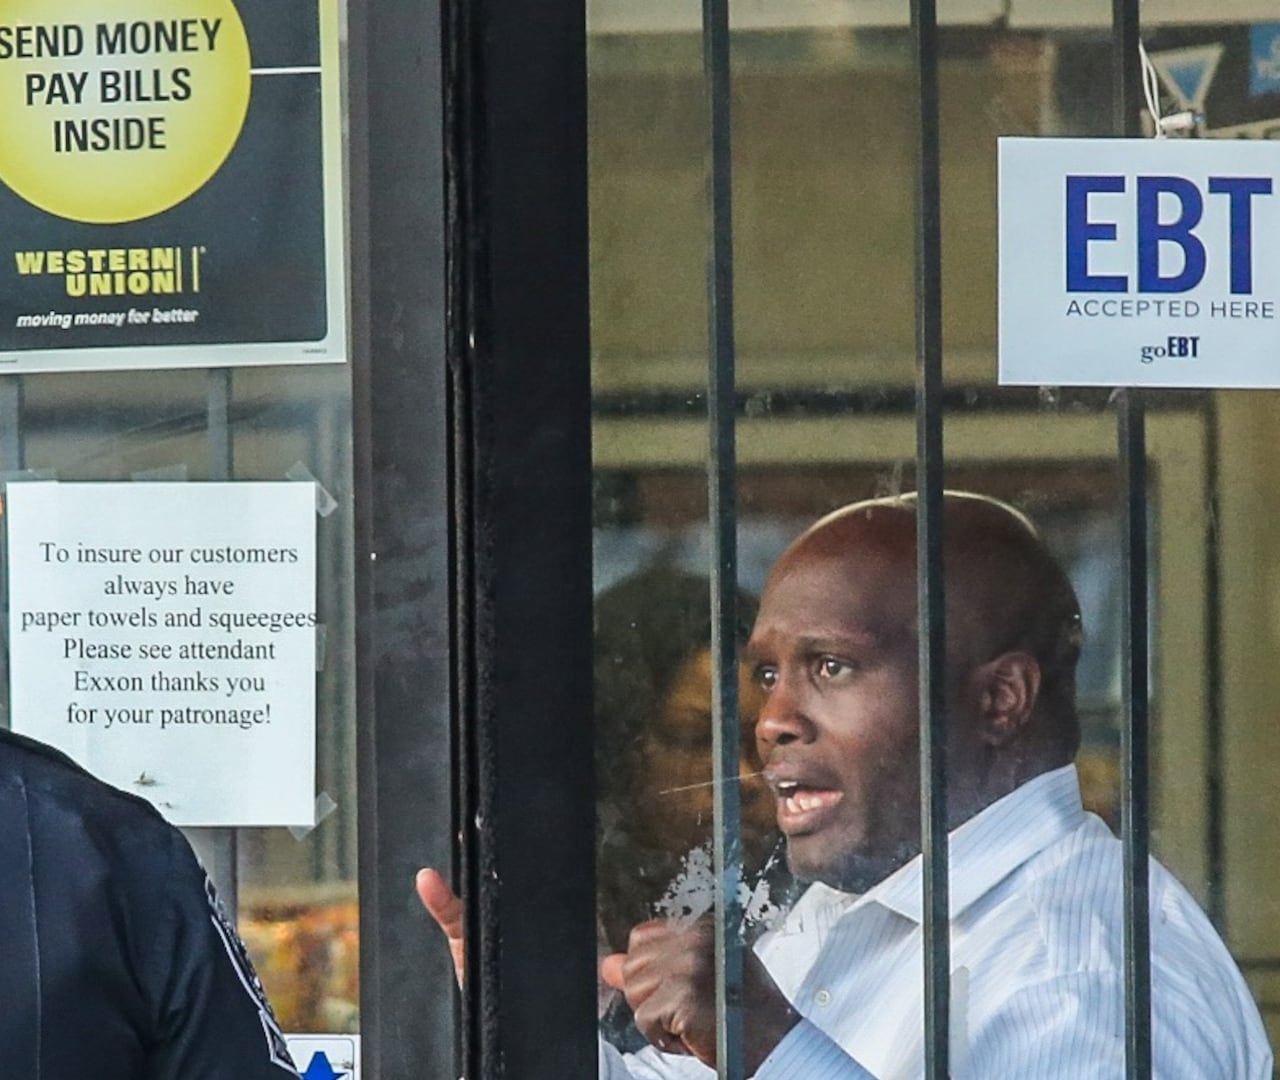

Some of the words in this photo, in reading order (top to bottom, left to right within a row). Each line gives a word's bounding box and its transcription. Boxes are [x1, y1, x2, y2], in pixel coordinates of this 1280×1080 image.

[96, 18, 222, 56] MONEY
[26, 71, 90, 106] PAY
[100, 66, 192, 104] BILLS
[53, 117, 168, 153] INSIDE
[1065, 175, 1273, 295] EBT
[14, 247, 175, 275] WESTERN
[65, 270, 176, 297] UNION
[16, 310, 73, 329] moving
[74, 312, 126, 327] money
[127, 308, 151, 325] for
[152, 307, 200, 324] better
[1065, 299, 1200, 318] ACCEPTED
[1210, 301, 1275, 319] HERE
[1140, 335, 1200, 364] goEBT
[38, 542, 70, 563] To
[77, 542, 143, 563] insure
[148, 547, 184, 563] our
[190, 544, 299, 563] customers
[103, 574, 178, 600] always
[184, 574, 235, 595] have
[20, 609, 82, 632] paper
[87, 606, 159, 628] towels
[164, 606, 202, 628] and
[208, 610, 319, 633] squeegees
[63, 638, 133, 659] Please
[138, 643, 173, 659] see
[178, 638, 276, 660] attendant
[73, 671, 144, 692] Exxon
[150, 670, 220, 692] thanks
[226, 676, 266, 697] you
[67, 702, 98, 724] for
[103, 707, 155, 729] your
[159, 703, 272, 729] patronage!
